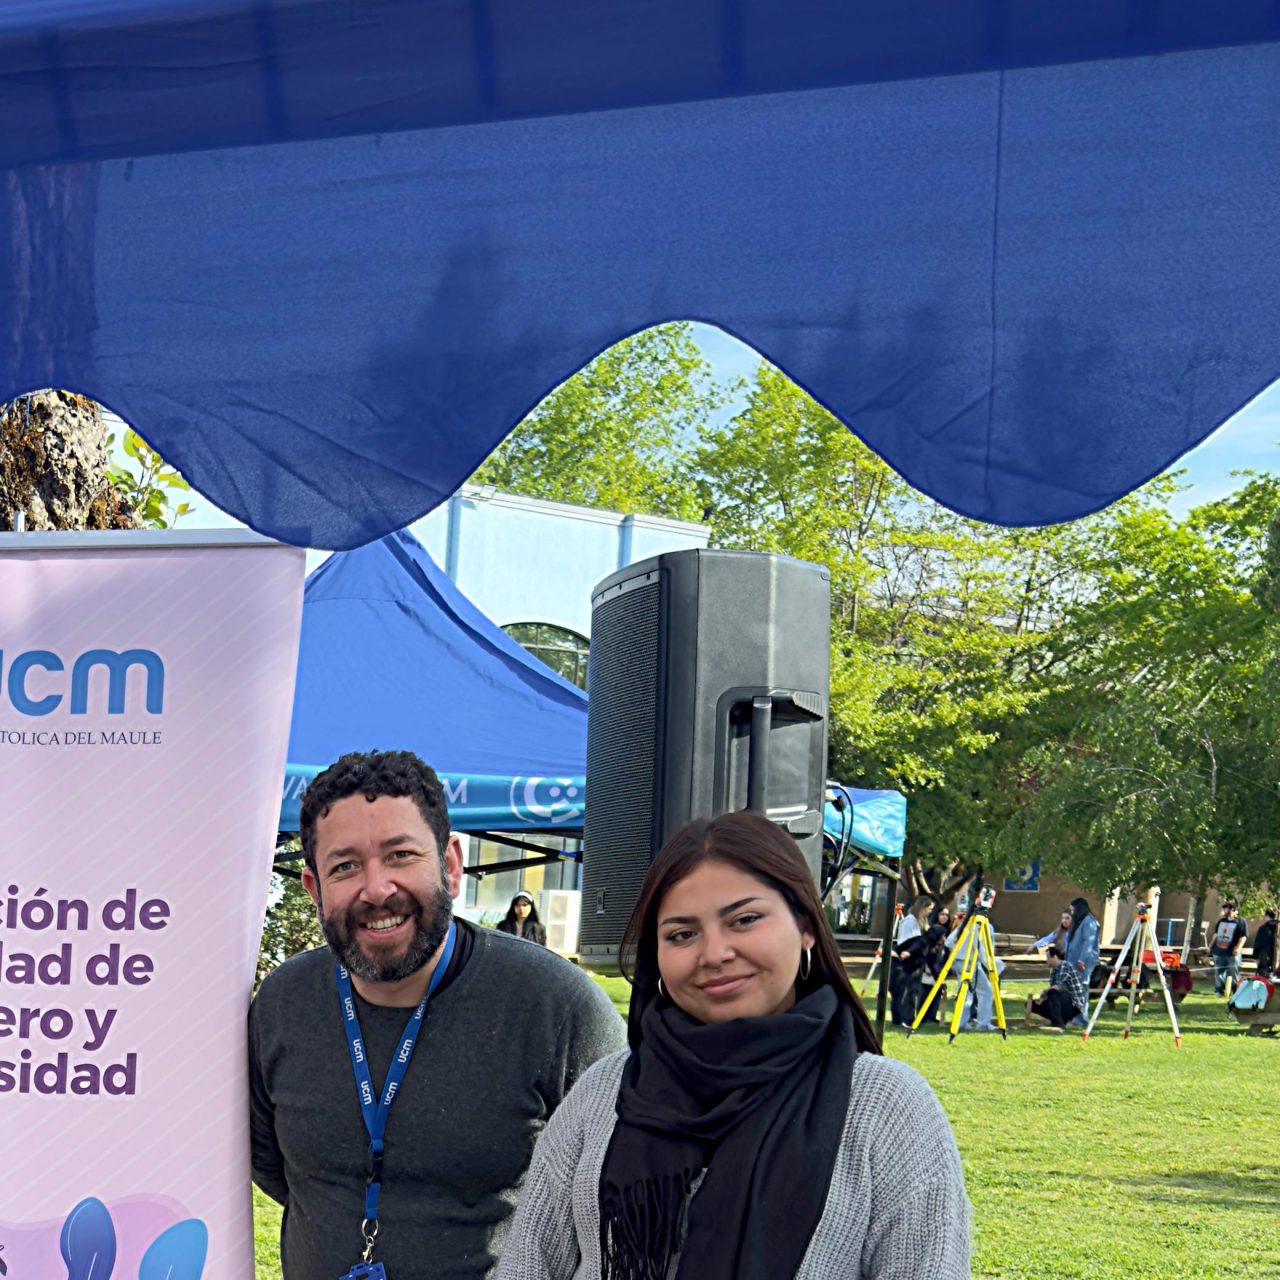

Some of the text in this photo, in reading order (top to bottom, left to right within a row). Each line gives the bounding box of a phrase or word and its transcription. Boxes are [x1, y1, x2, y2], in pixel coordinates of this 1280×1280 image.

[64, 731, 97, 746] DEL
[100, 731, 162, 746] MAULE
[102, 888, 171, 931] de
[86, 943, 154, 986] de
[82, 1008, 118, 1051] y
